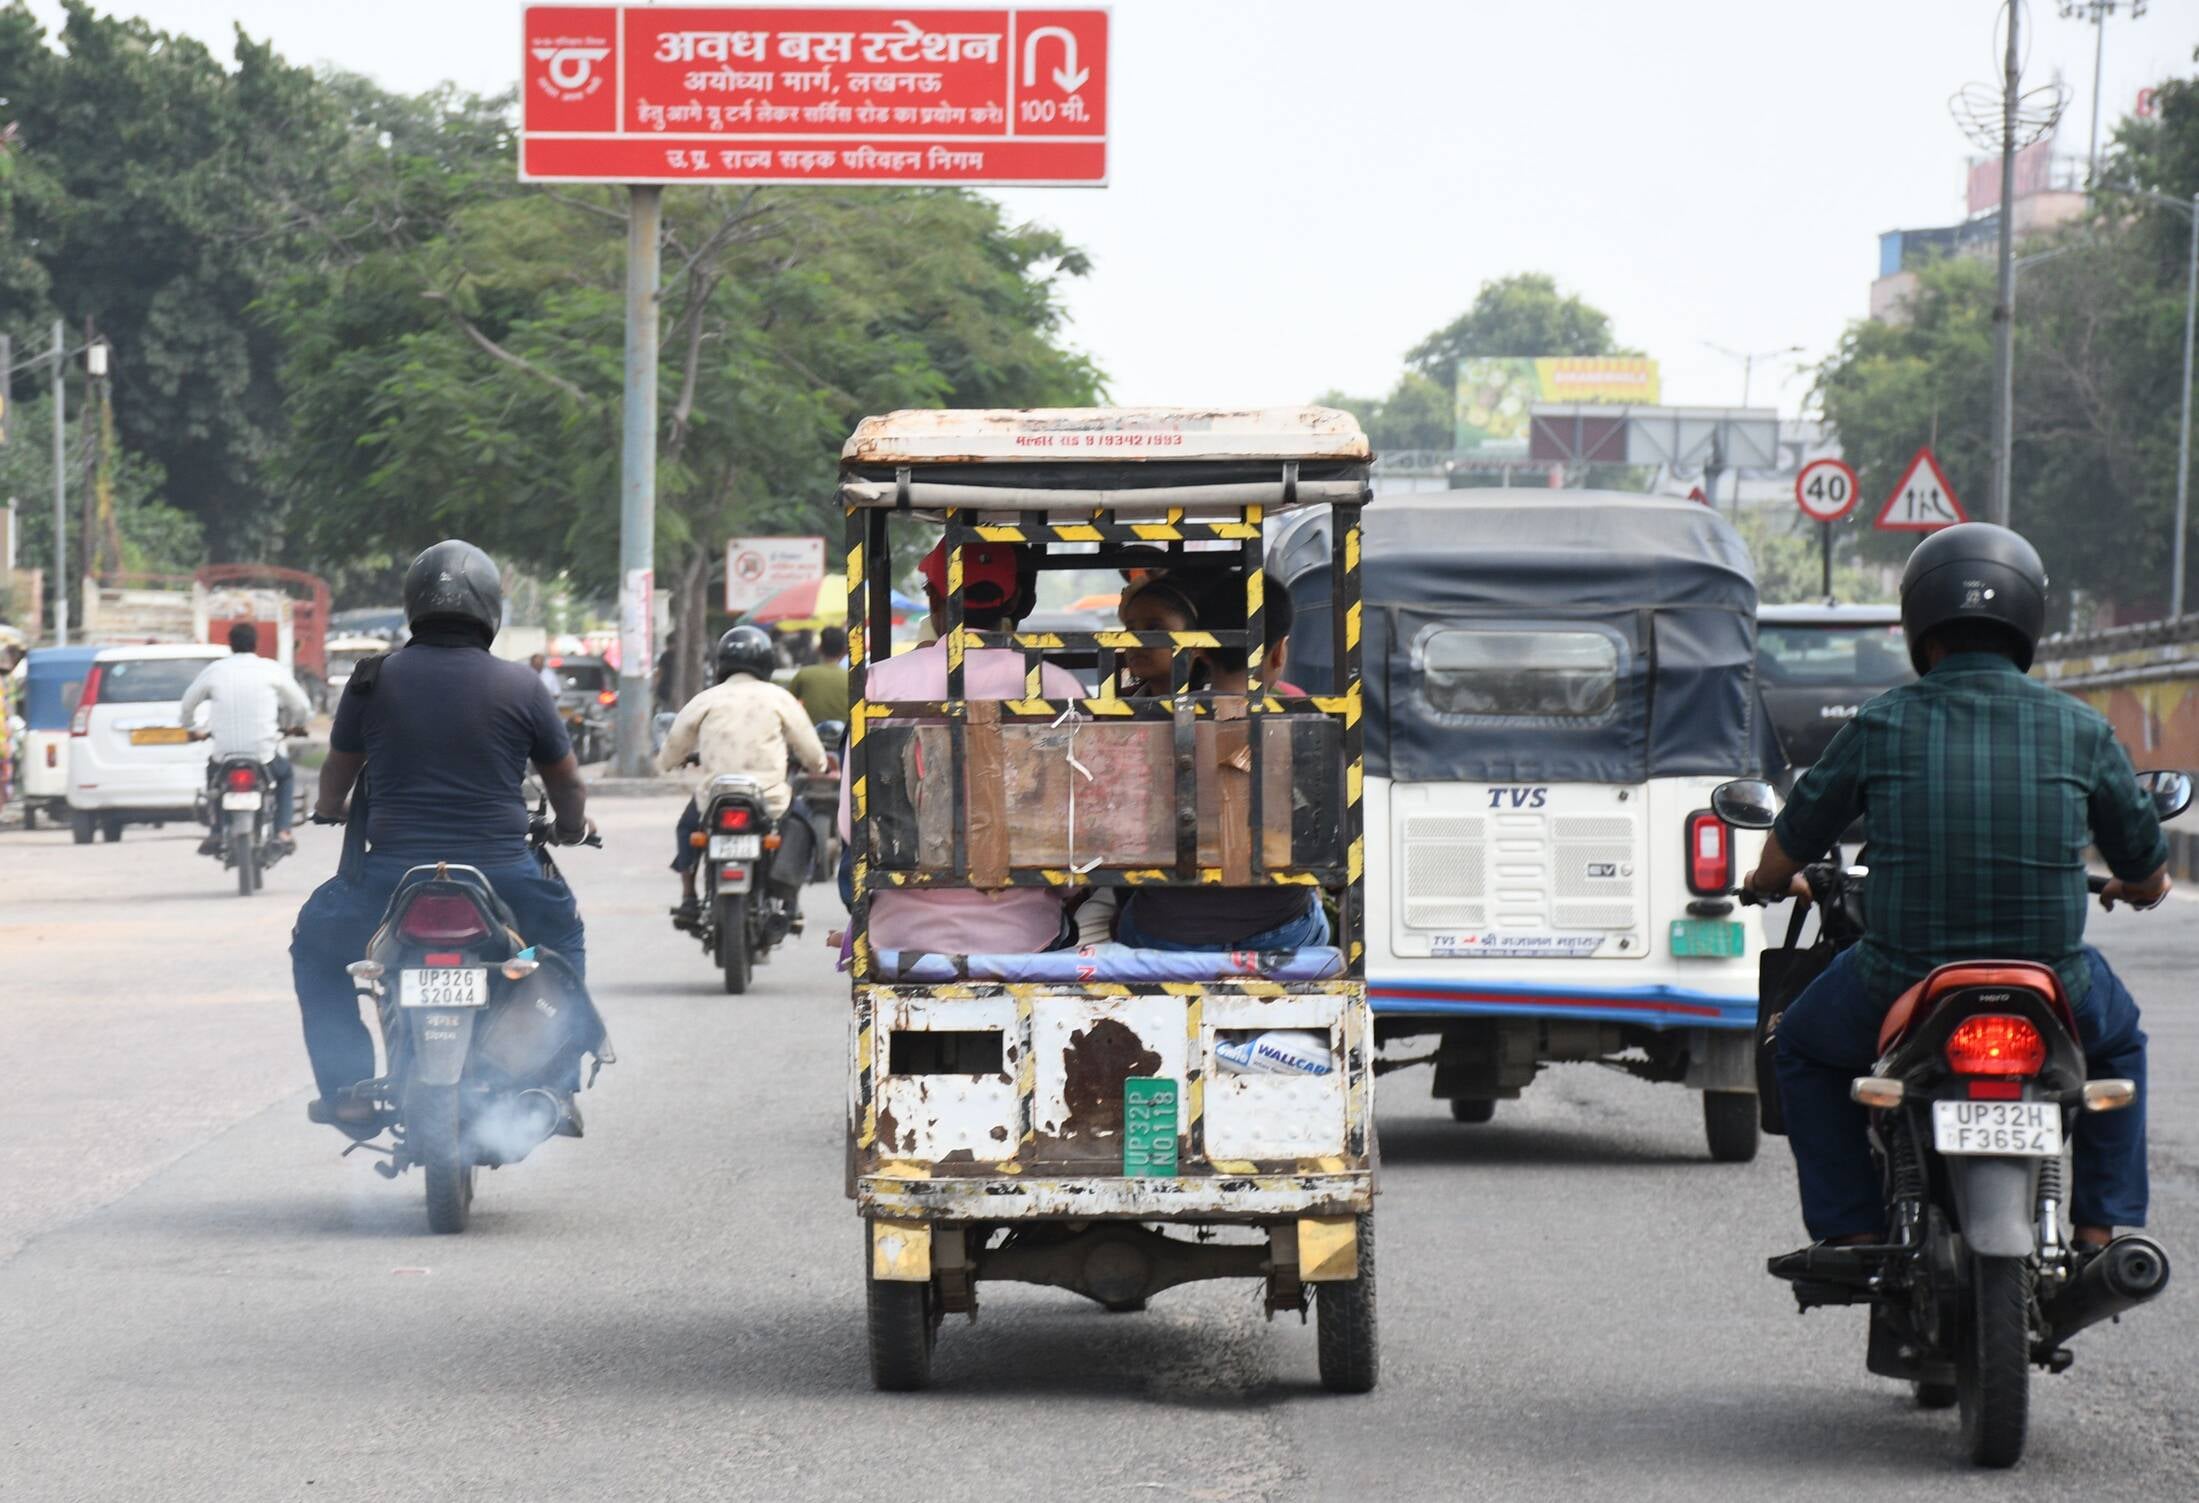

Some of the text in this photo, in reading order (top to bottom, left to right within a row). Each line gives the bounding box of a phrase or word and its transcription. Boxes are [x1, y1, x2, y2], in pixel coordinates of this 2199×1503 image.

[654, 19, 1002, 63] अवध बस स्टेशन
[684, 63, 774, 92] अयोध्या
[846, 72, 943, 92] लखनऊ
[637, 98, 666, 131] हेतु
[667, 98, 702, 122] आगे
[724, 98, 754, 122] टर्न
[756, 99, 800, 122] लेकर
[803, 99, 852, 123] सर्विस
[856, 99, 890, 123] रोड
[894, 107, 917, 123] का
[920, 100, 967, 124] प्रयोग
[1020, 94, 1091, 122] 100 मी.
[719, 150, 772, 170] राज्य
[777, 150, 837, 172] सड़क
[842, 144, 922, 172] परिवहन
[927, 145, 984, 171] निगम
[1807, 475, 1845, 501] 40
[1488, 788, 1548, 808] TVS
[419, 970, 474, 987] UP32G
[421, 988, 474, 1004] S2044
[1128, 1092, 1151, 1166] UP32P
[1957, 1104, 2043, 1127] UP32H
[1958, 1128, 2045, 1151] F3654
